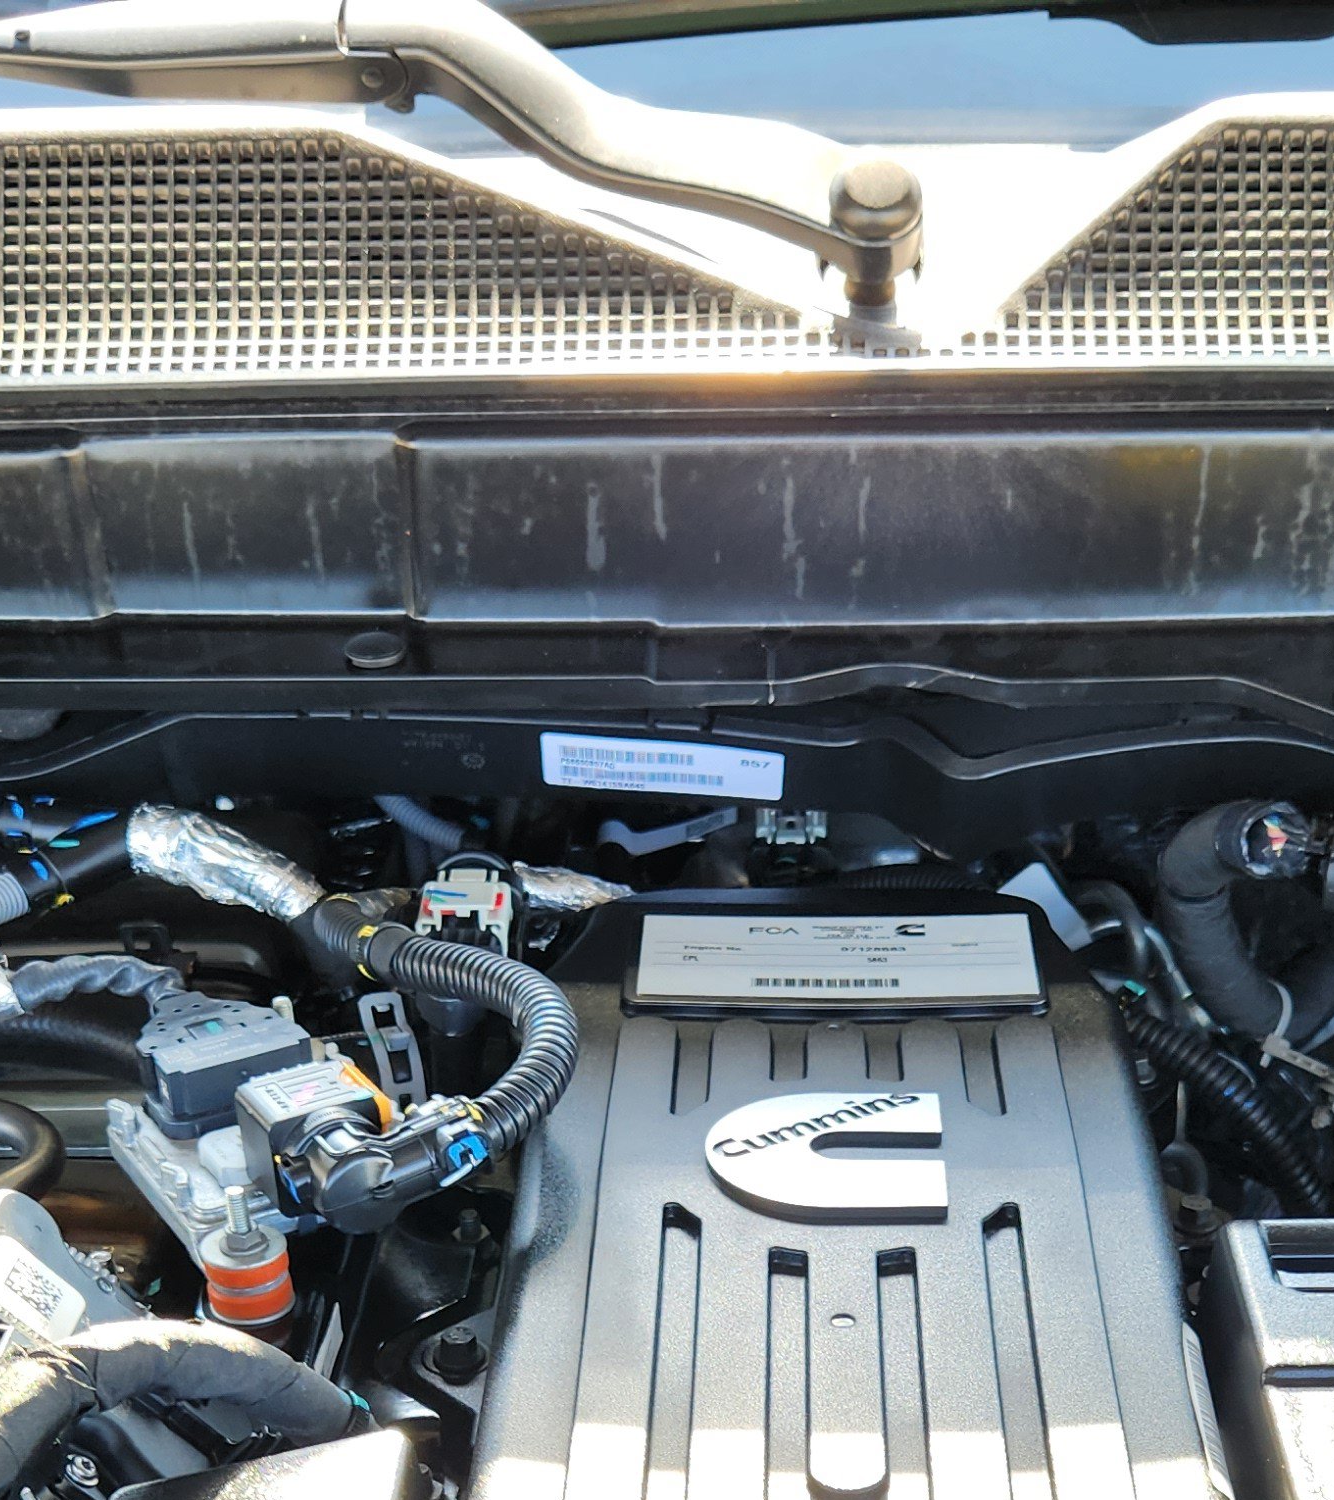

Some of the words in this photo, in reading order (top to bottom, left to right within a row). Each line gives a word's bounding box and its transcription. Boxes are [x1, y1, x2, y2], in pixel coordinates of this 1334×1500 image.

[740, 759, 771, 769] 857
[748, 926, 799, 935] FCA
[712, 1092, 921, 1158] Cummins
